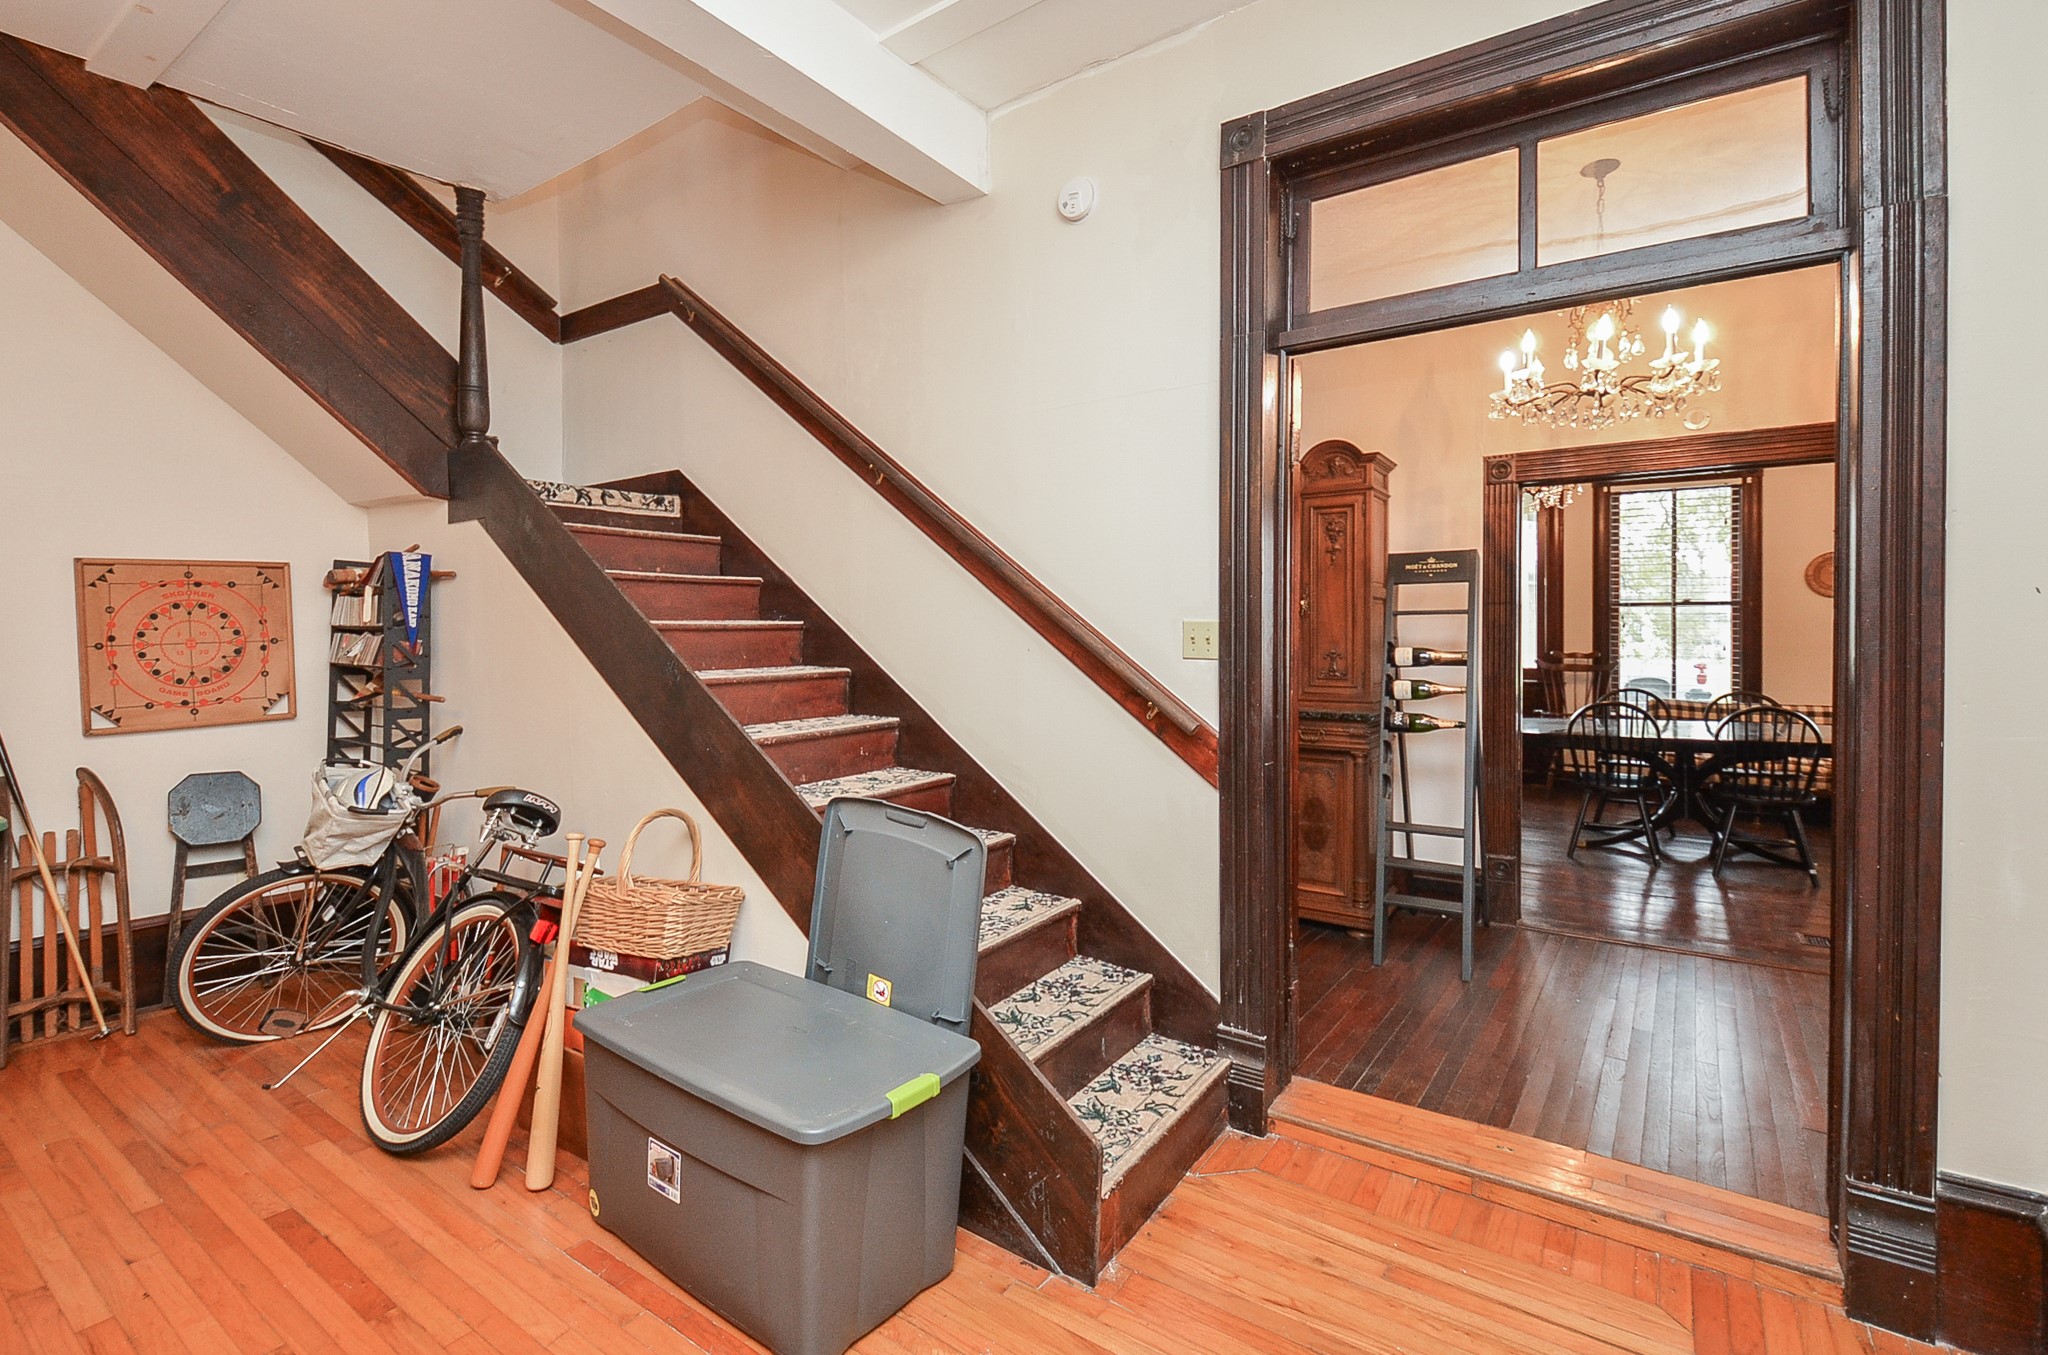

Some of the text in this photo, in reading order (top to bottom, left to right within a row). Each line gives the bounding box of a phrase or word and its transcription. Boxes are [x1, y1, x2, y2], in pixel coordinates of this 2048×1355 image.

[159, 682, 230, 697] GAME BOARD
[589, 957, 618, 970] STAR
